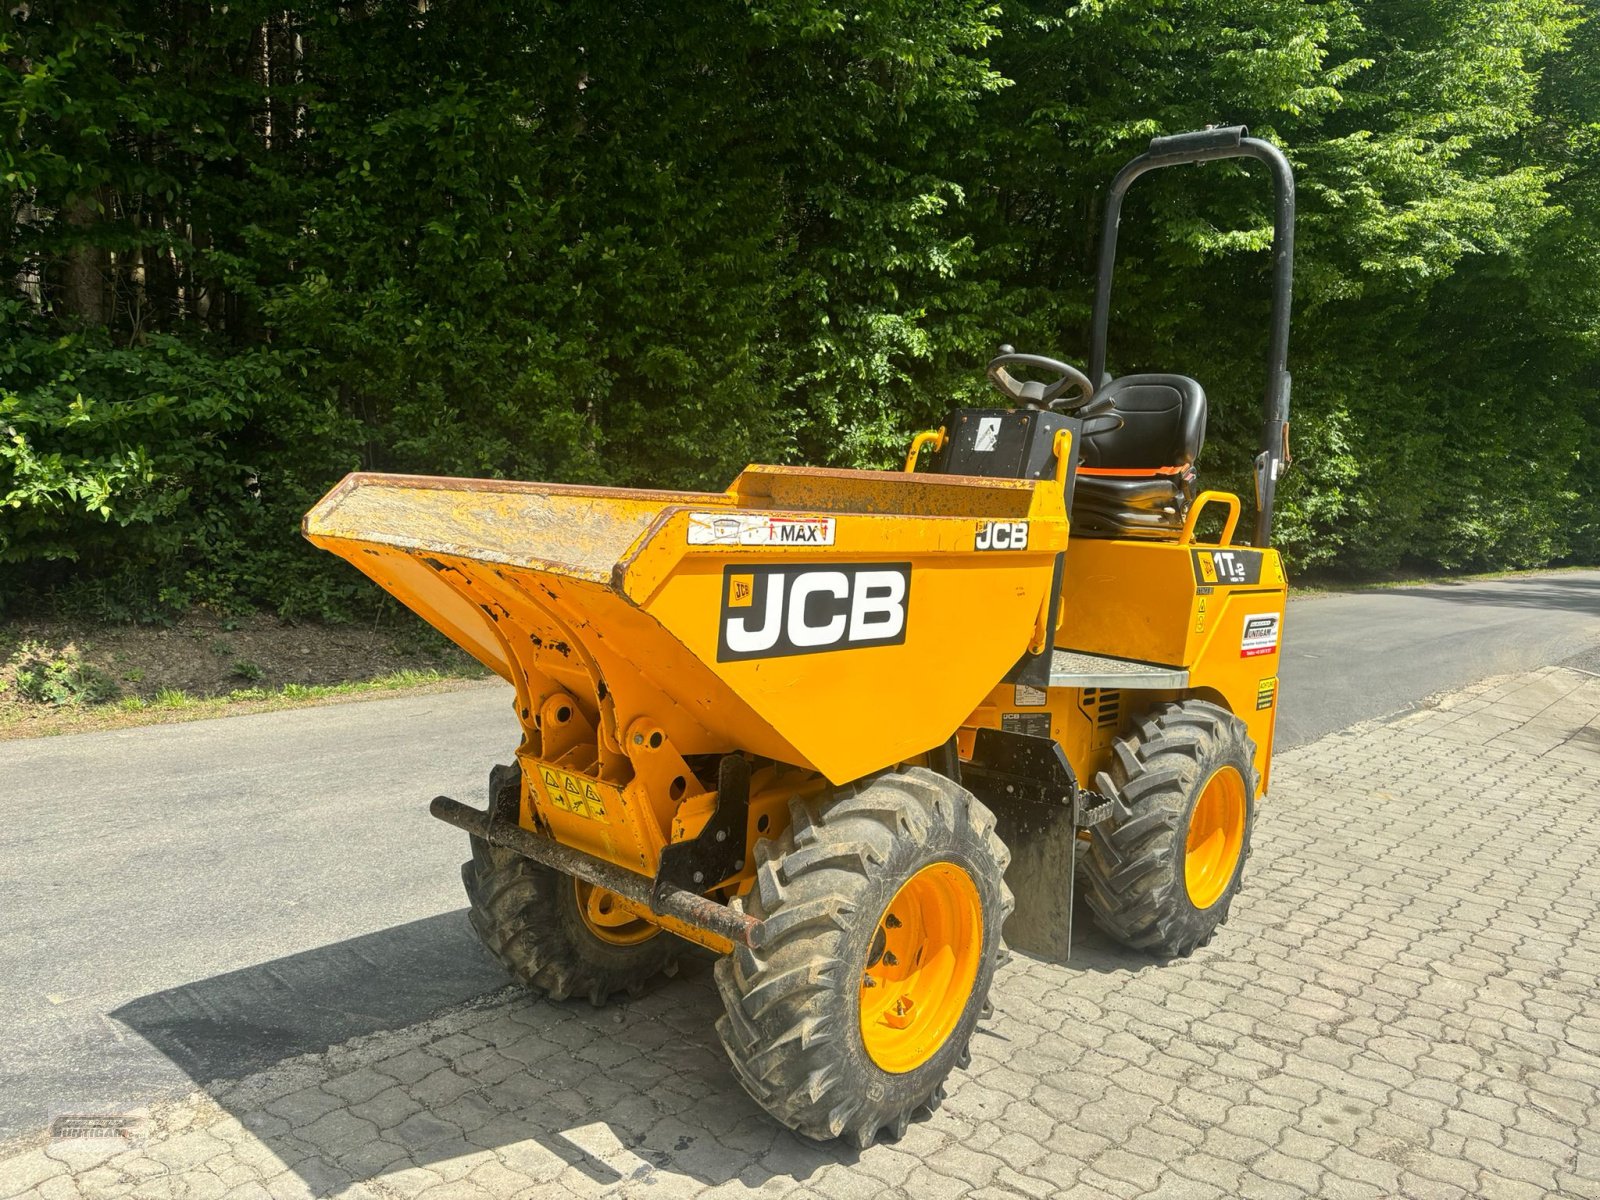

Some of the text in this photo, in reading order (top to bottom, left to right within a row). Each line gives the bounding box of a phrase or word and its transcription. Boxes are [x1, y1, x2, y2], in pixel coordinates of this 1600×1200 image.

[780, 524, 818, 542] MAX
[975, 522, 1028, 549] JCB
[735, 582, 750, 599] JCB
[726, 571, 906, 652] JCB
